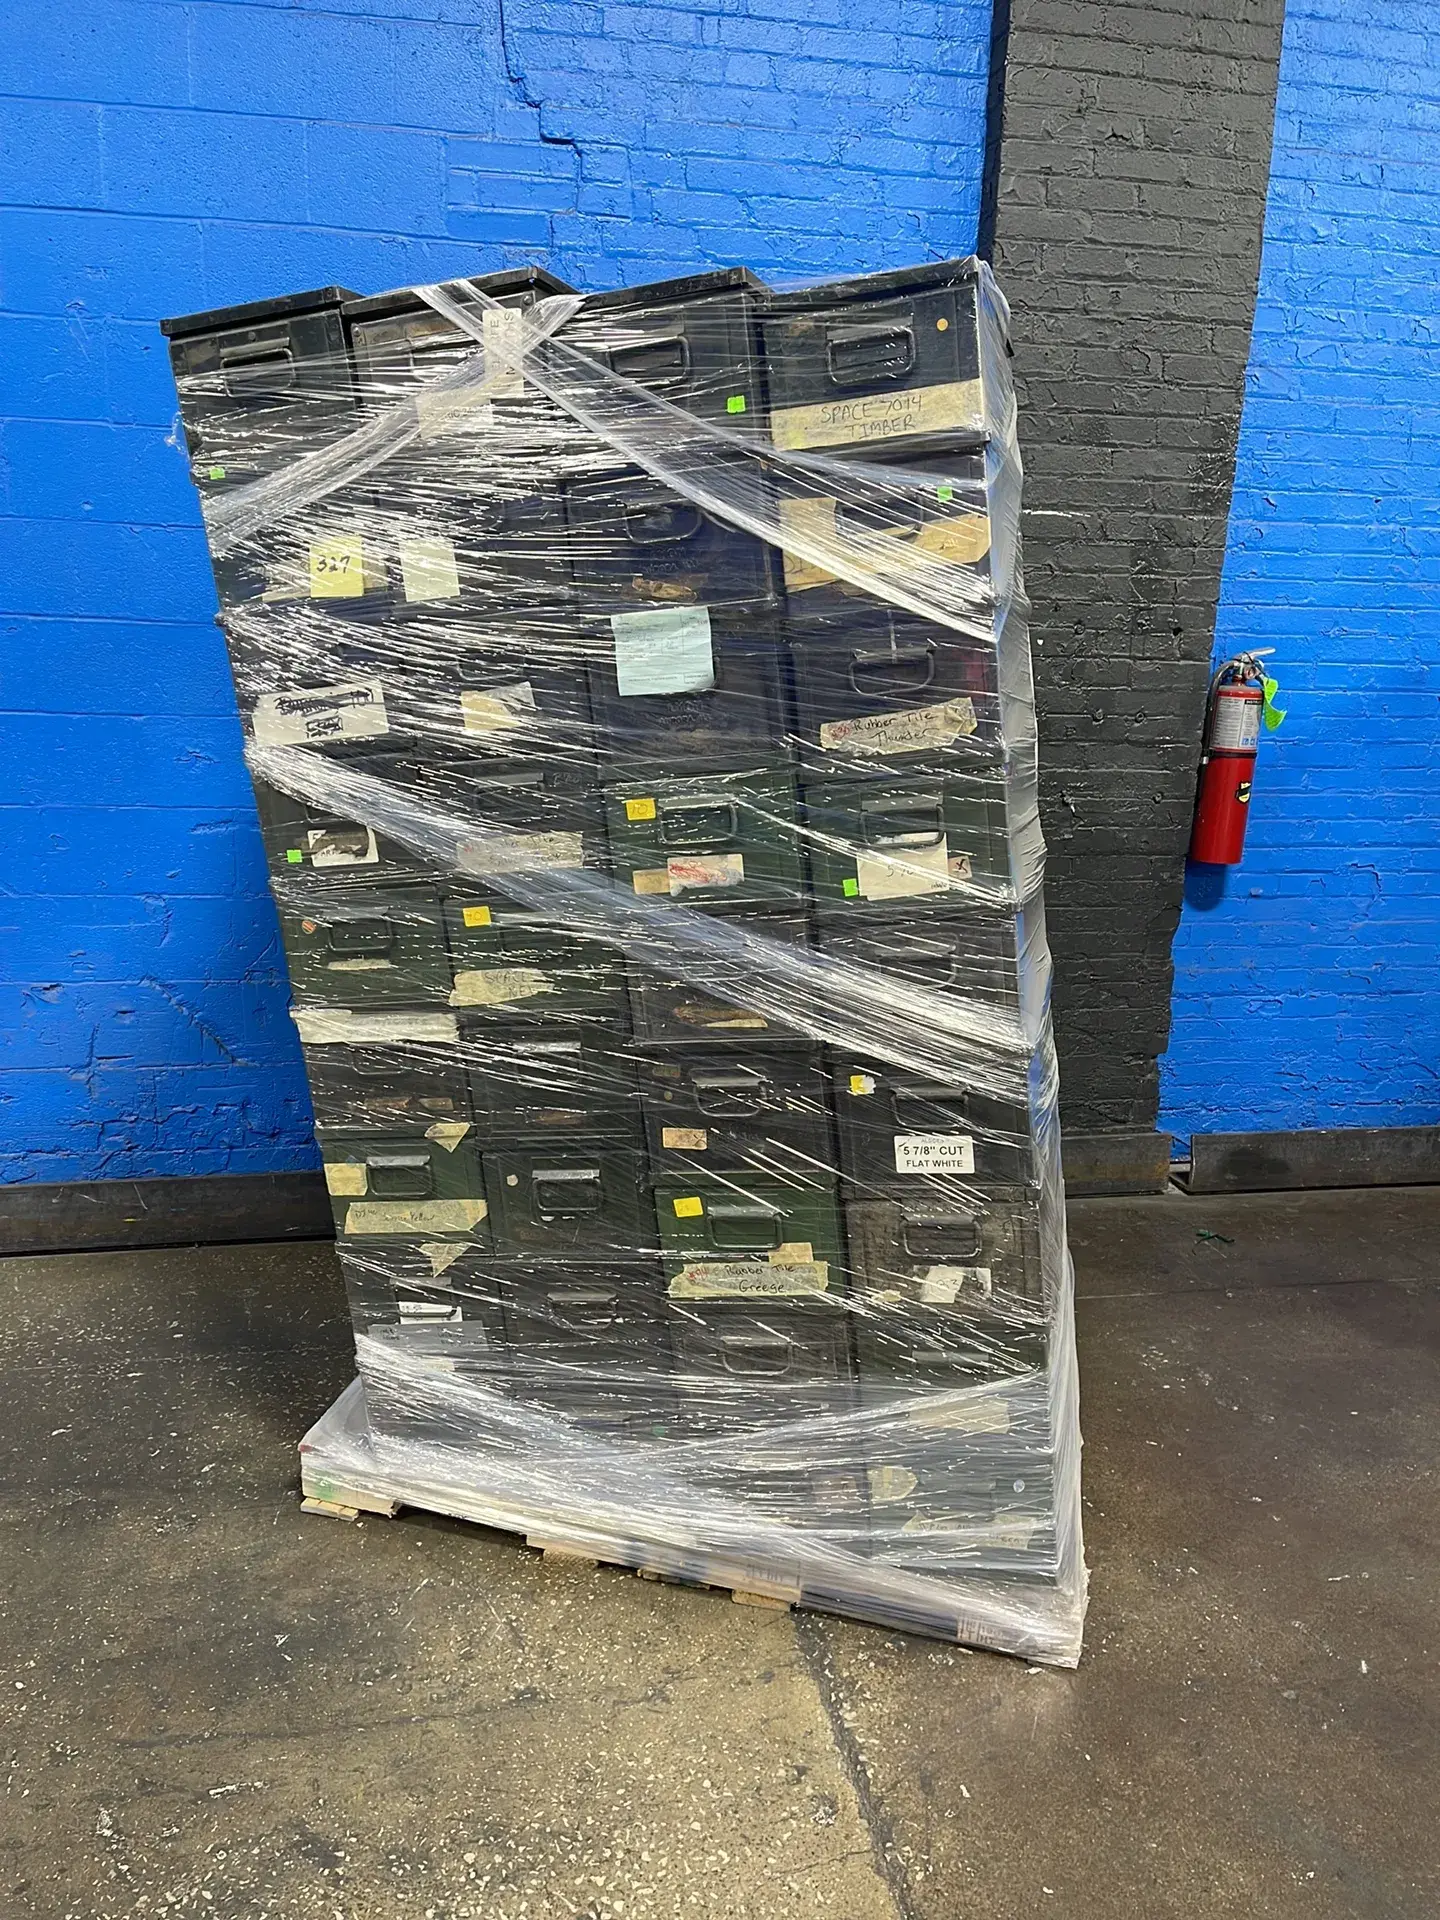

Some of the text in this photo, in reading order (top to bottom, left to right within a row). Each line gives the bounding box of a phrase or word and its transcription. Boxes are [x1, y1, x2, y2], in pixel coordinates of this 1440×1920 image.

[821, 394, 922, 424] SPACE 7014
[845, 413, 916, 440] TIMBER
[316, 554, 351, 574] 327
[853, 716, 897, 731] Rubber
[902, 710, 938, 723] Tile
[871, 727, 940, 747] Thunder
[903, 1146, 964, 1156] 5 7/8" CUT
[906, 1160, 963, 1168] FLAT WHITE
[725, 1265, 765, 1276] Rubber
[774, 1264, 796, 1273] Tile
[739, 1280, 785, 1293] Greege
